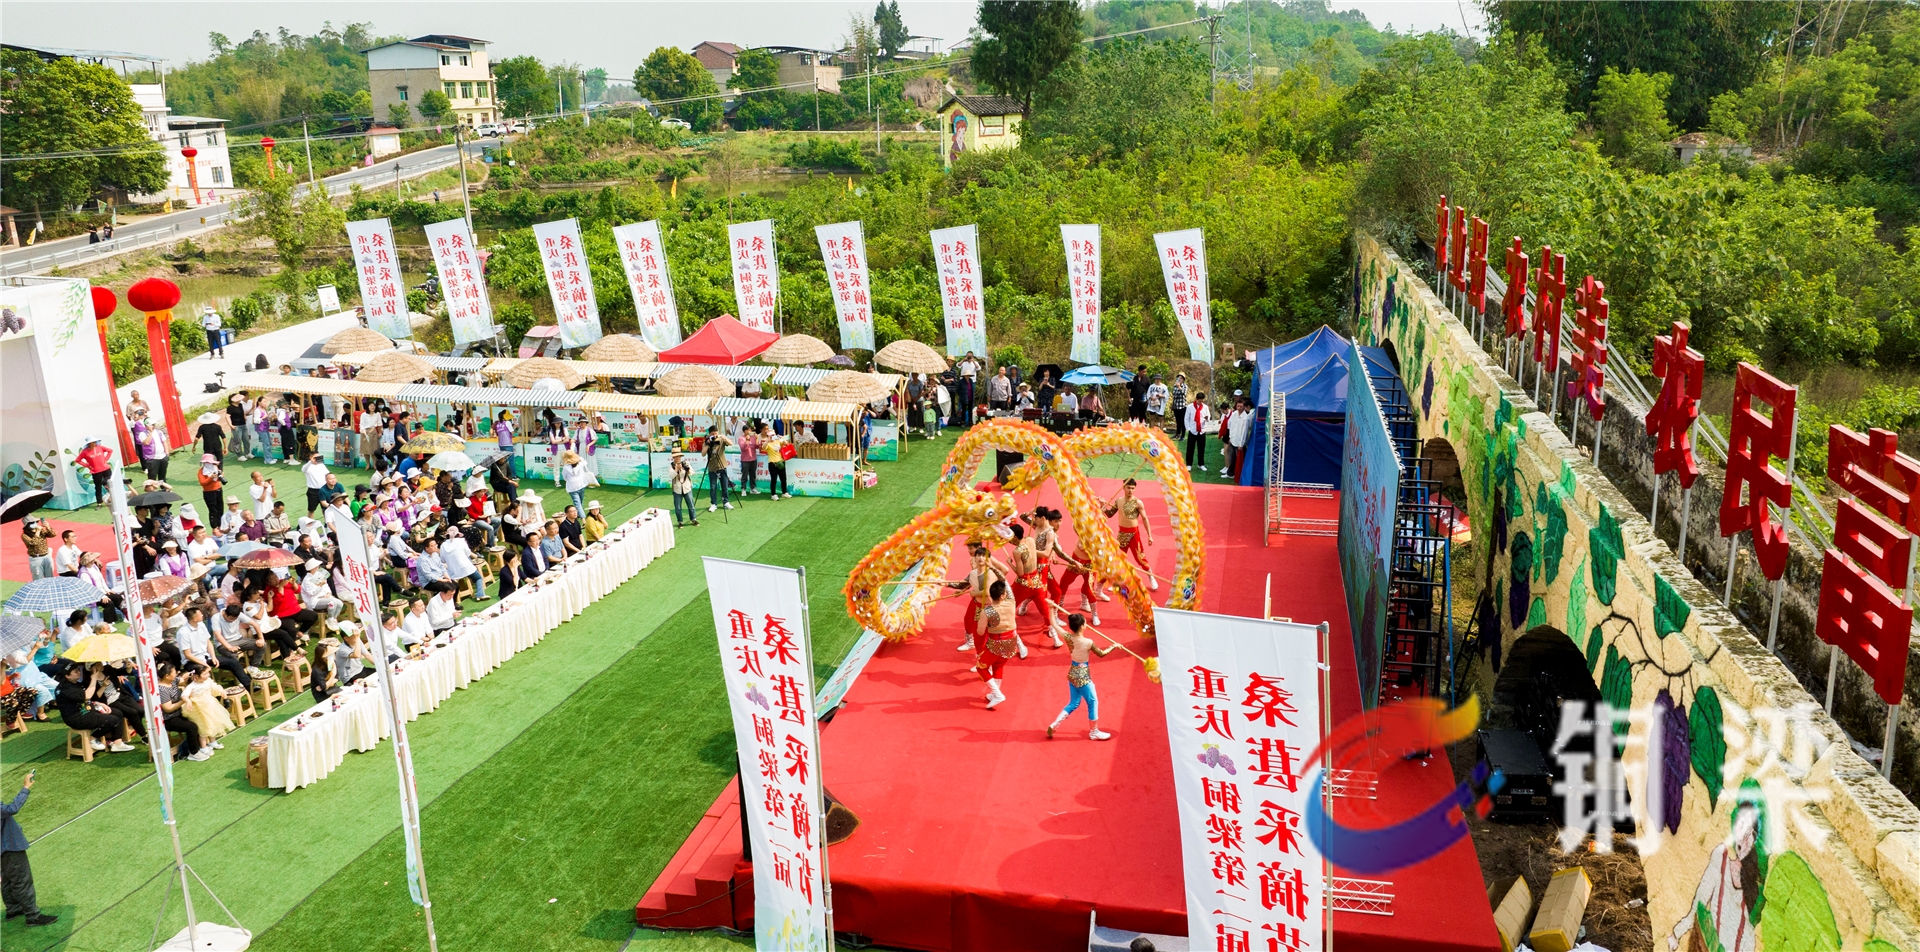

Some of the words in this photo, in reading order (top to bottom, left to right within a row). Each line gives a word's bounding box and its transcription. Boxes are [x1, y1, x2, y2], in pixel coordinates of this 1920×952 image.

[1502, 236, 1608, 421] 农村美
[1645, 321, 1920, 705] 农民富
